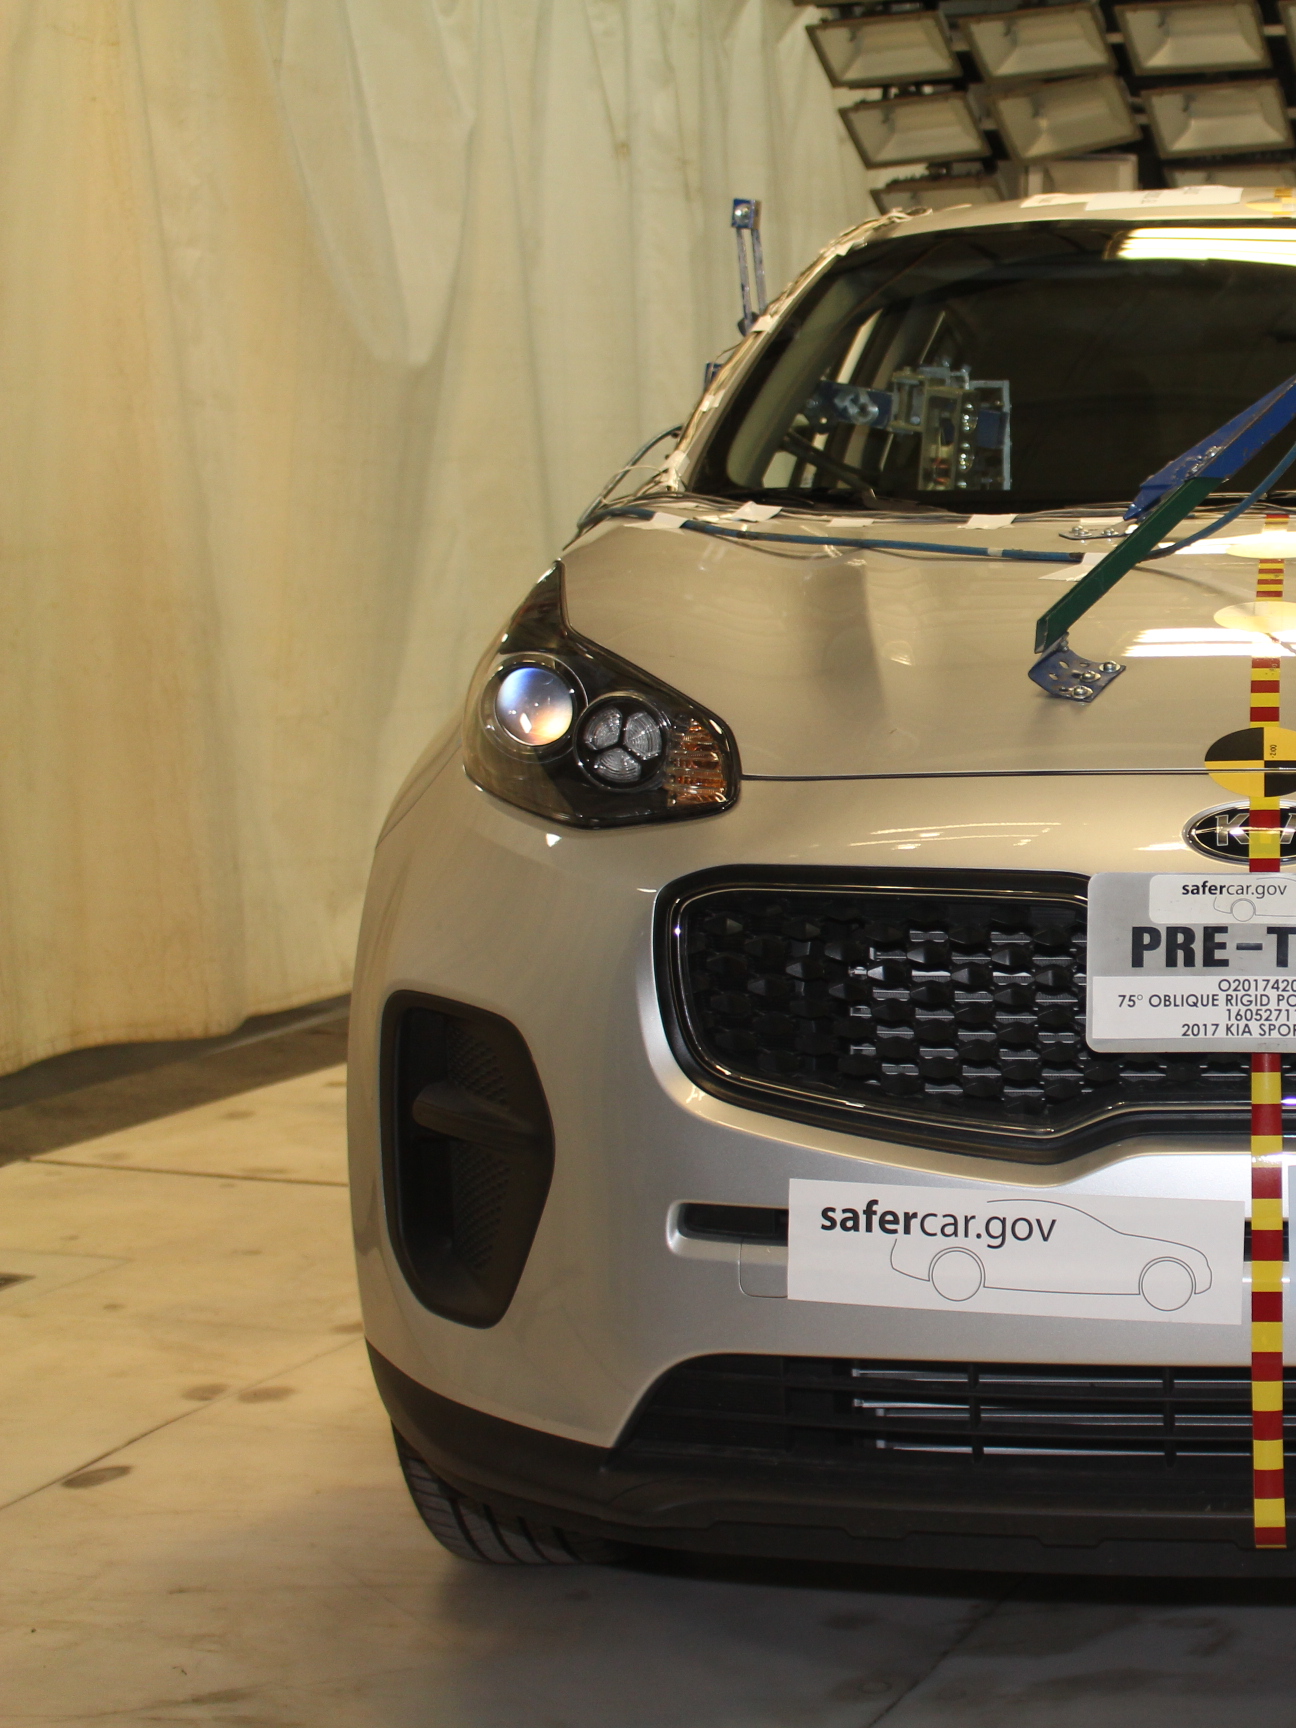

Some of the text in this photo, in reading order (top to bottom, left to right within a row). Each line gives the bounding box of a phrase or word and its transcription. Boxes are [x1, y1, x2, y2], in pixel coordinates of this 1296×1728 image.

[1181, 880, 1288, 899] safercar.gov
[1118, 994, 1143, 1008] 75°
[1148, 994, 1219, 1009] OBLIQUE
[1225, 994, 1270, 1007] RIGID
[1181, 1023, 1219, 1037] 2017
[1225, 1023, 1253, 1036] KIA
[820, 1199, 1057, 1250] safercar.gov
